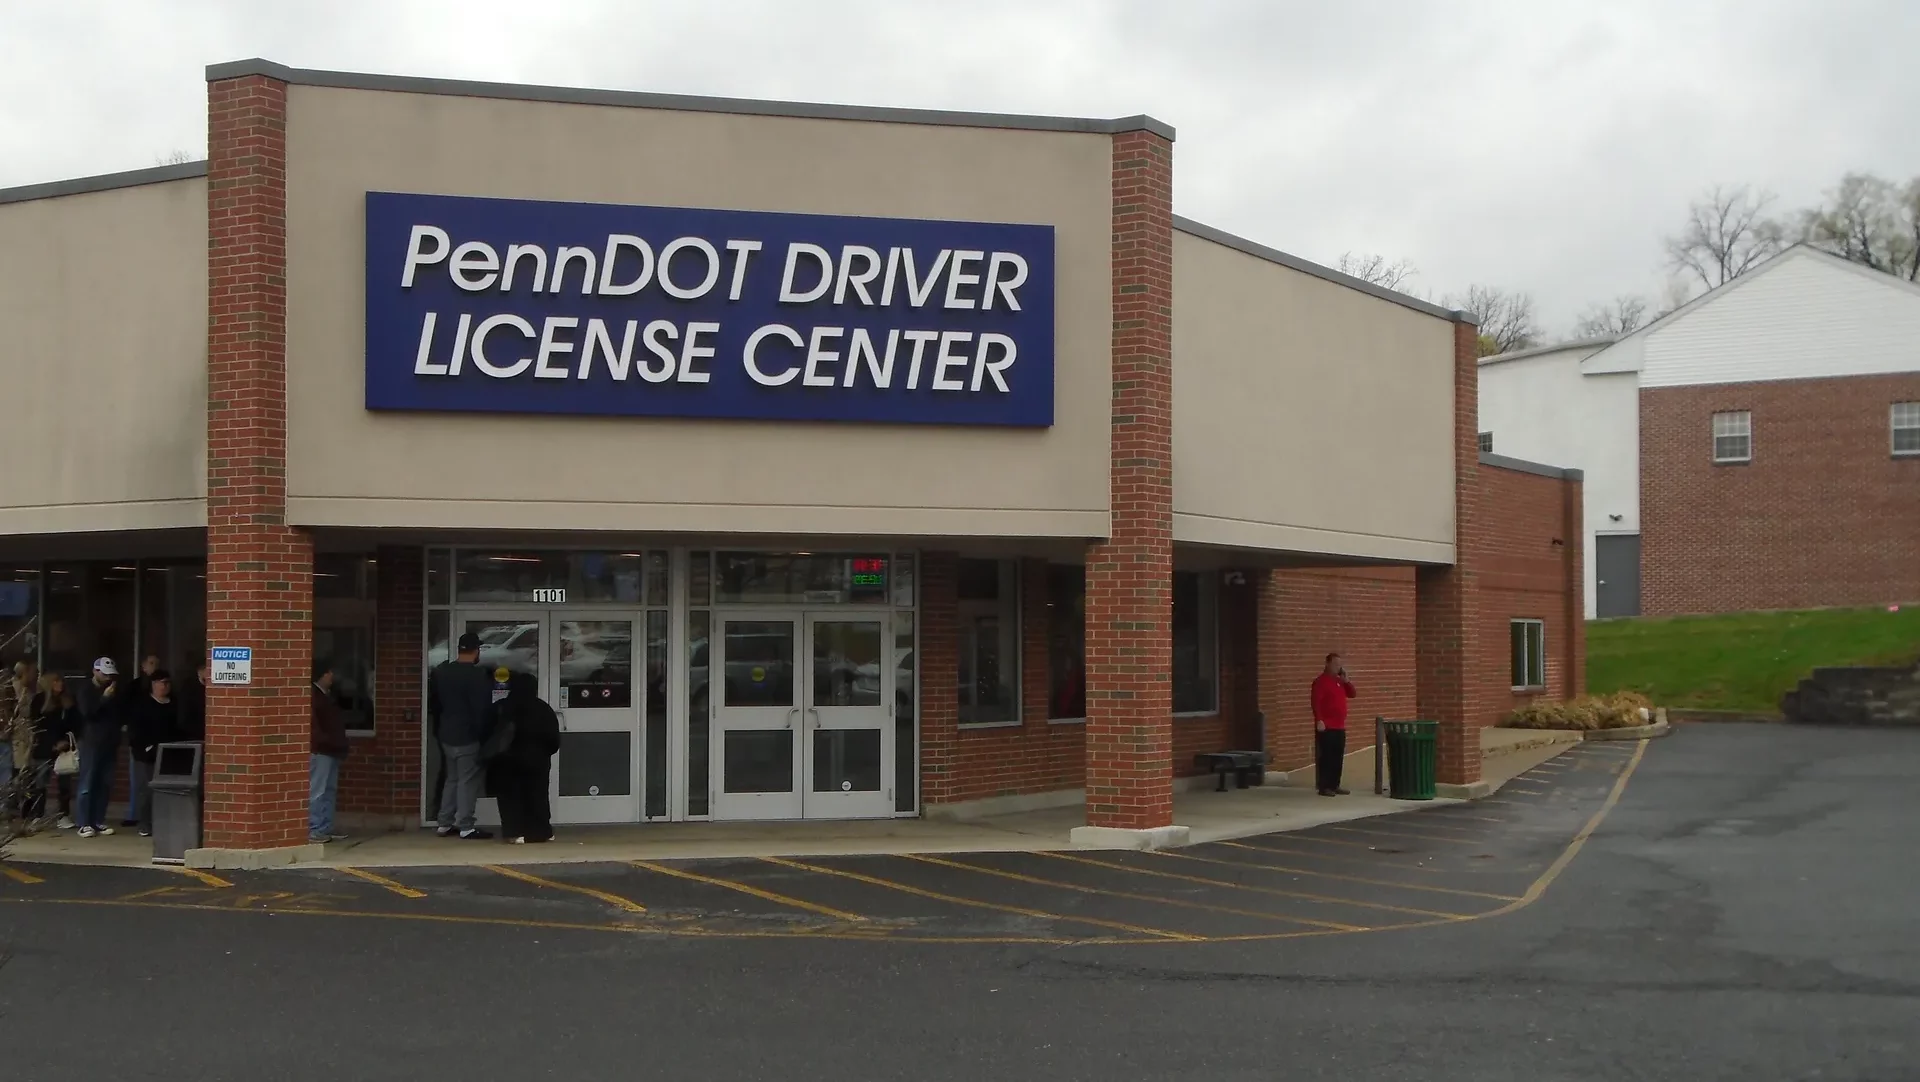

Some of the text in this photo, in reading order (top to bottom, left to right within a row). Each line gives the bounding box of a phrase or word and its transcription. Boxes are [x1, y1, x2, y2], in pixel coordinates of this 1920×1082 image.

[400, 225, 1029, 311] PennDOT DRIVER
[414, 312, 1017, 393] LICENSE CENTER
[535, 589, 564, 602] 1101
[214, 650, 248, 659] NOTICE
[226, 661, 236, 670] NO
[215, 672, 247, 681] LOITERING
